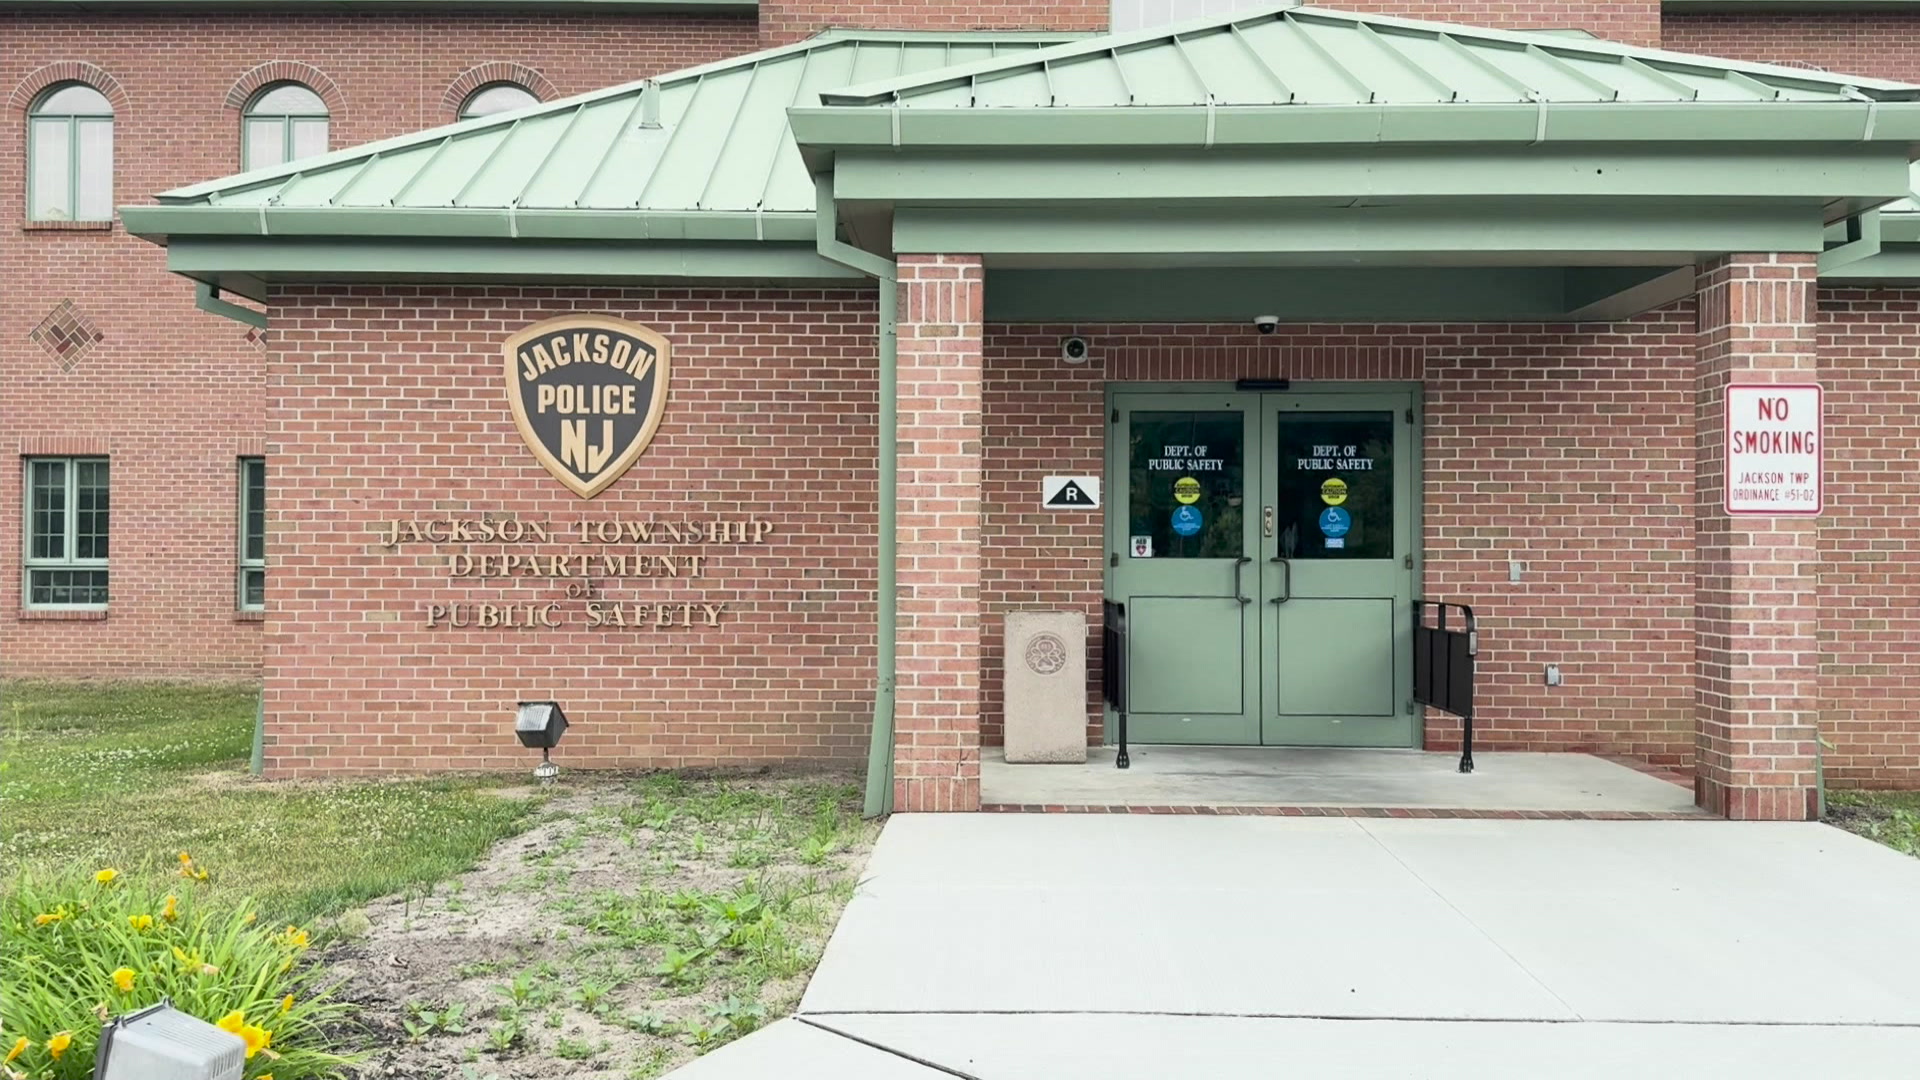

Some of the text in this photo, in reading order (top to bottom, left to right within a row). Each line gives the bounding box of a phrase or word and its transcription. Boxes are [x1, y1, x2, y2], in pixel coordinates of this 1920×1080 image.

[520, 333, 655, 381] JACKSON
[538, 384, 636, 414] POLICE
[1758, 397, 1789, 421] NO
[561, 419, 614, 473] NJ
[1164, 445, 1207, 457] DEPT. OF
[1312, 445, 1357, 457] DEPT. OF
[1733, 430, 1815, 454] SMOKING
[1148, 459, 1224, 471] PUBLIC SAFETY
[1297, 458, 1374, 470] PUBLIC SAFETY
[1738, 472, 1810, 484] JACKSON TWP
[1065, 487, 1078, 501] R
[1733, 488, 1815, 501] ORDINANCE #51-02
[382, 518, 774, 547] JACKSON TOWNSHIP
[448, 554, 706, 578] DEPARTMENT
[565, 583, 597, 599] OF
[425, 603, 726, 629] PUBLIC SAFETY
